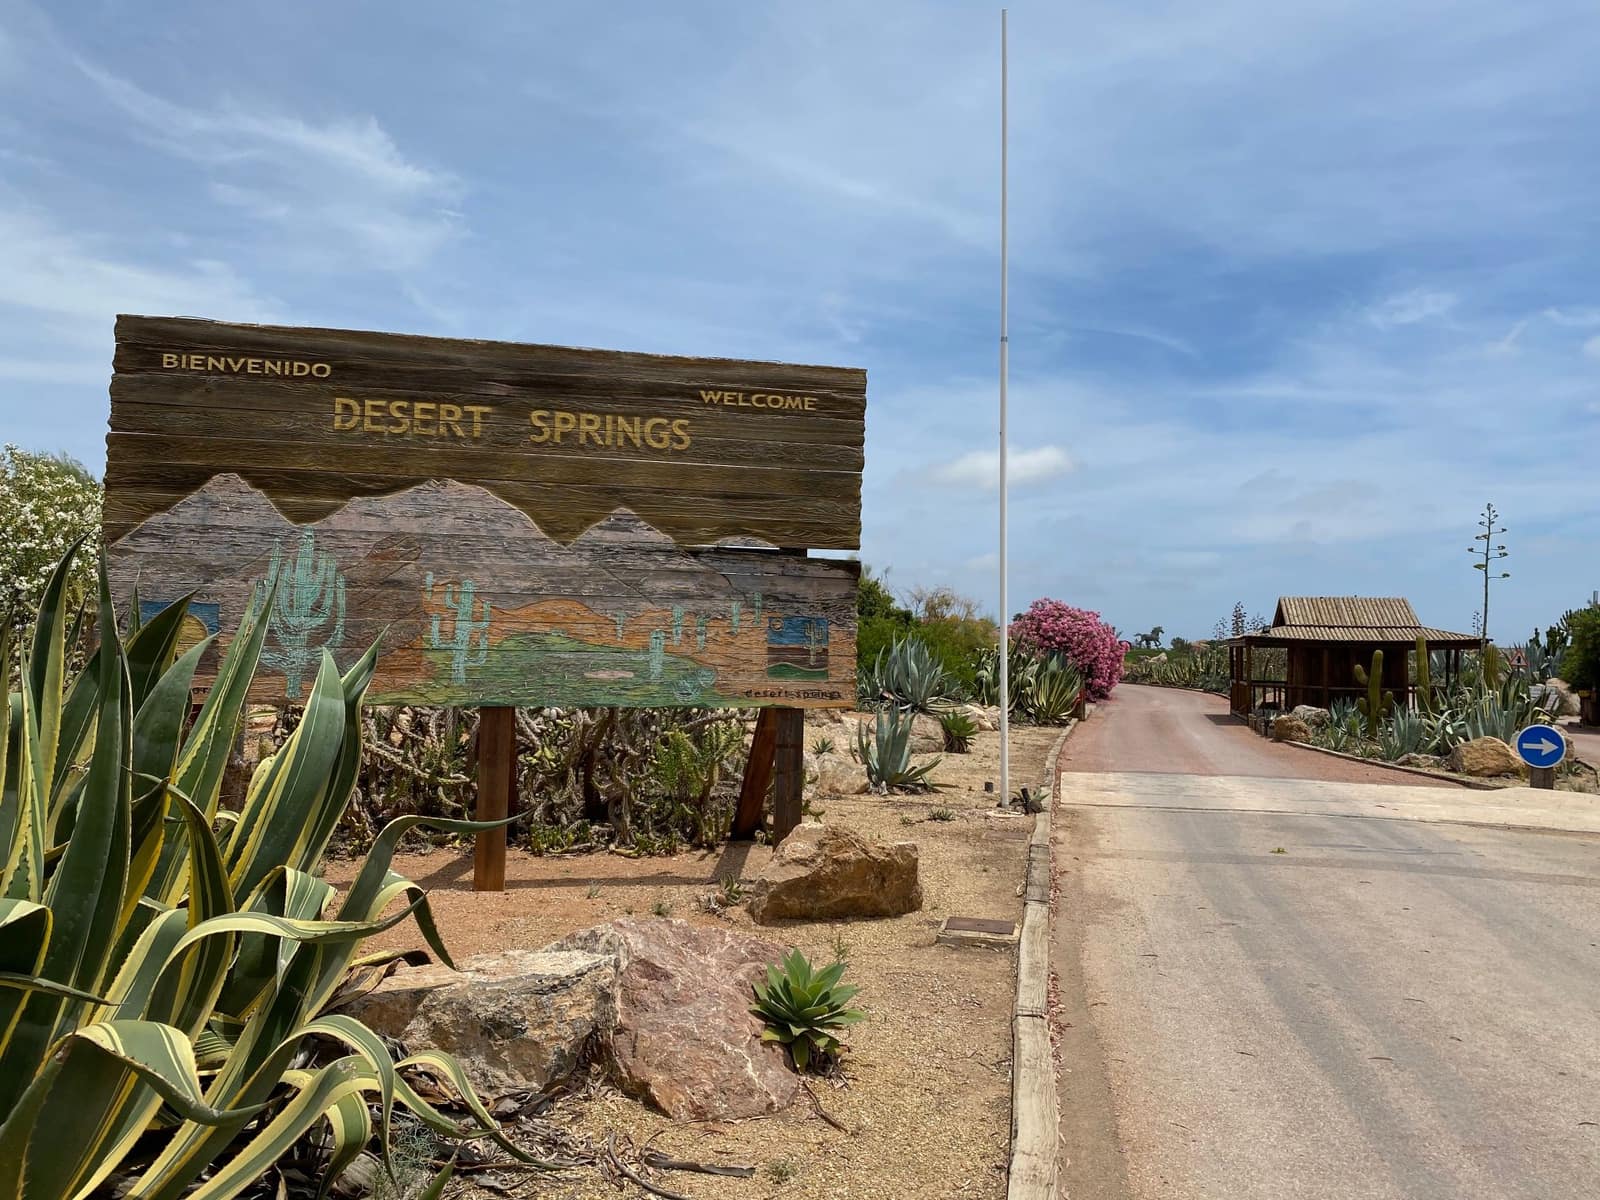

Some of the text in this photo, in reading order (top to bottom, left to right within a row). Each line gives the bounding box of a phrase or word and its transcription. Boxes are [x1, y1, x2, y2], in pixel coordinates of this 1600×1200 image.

[162, 353, 332, 379] BIENVENIDO
[700, 390, 818, 411] WELCOME
[333, 397, 693, 450] DESERT SPRINGS
